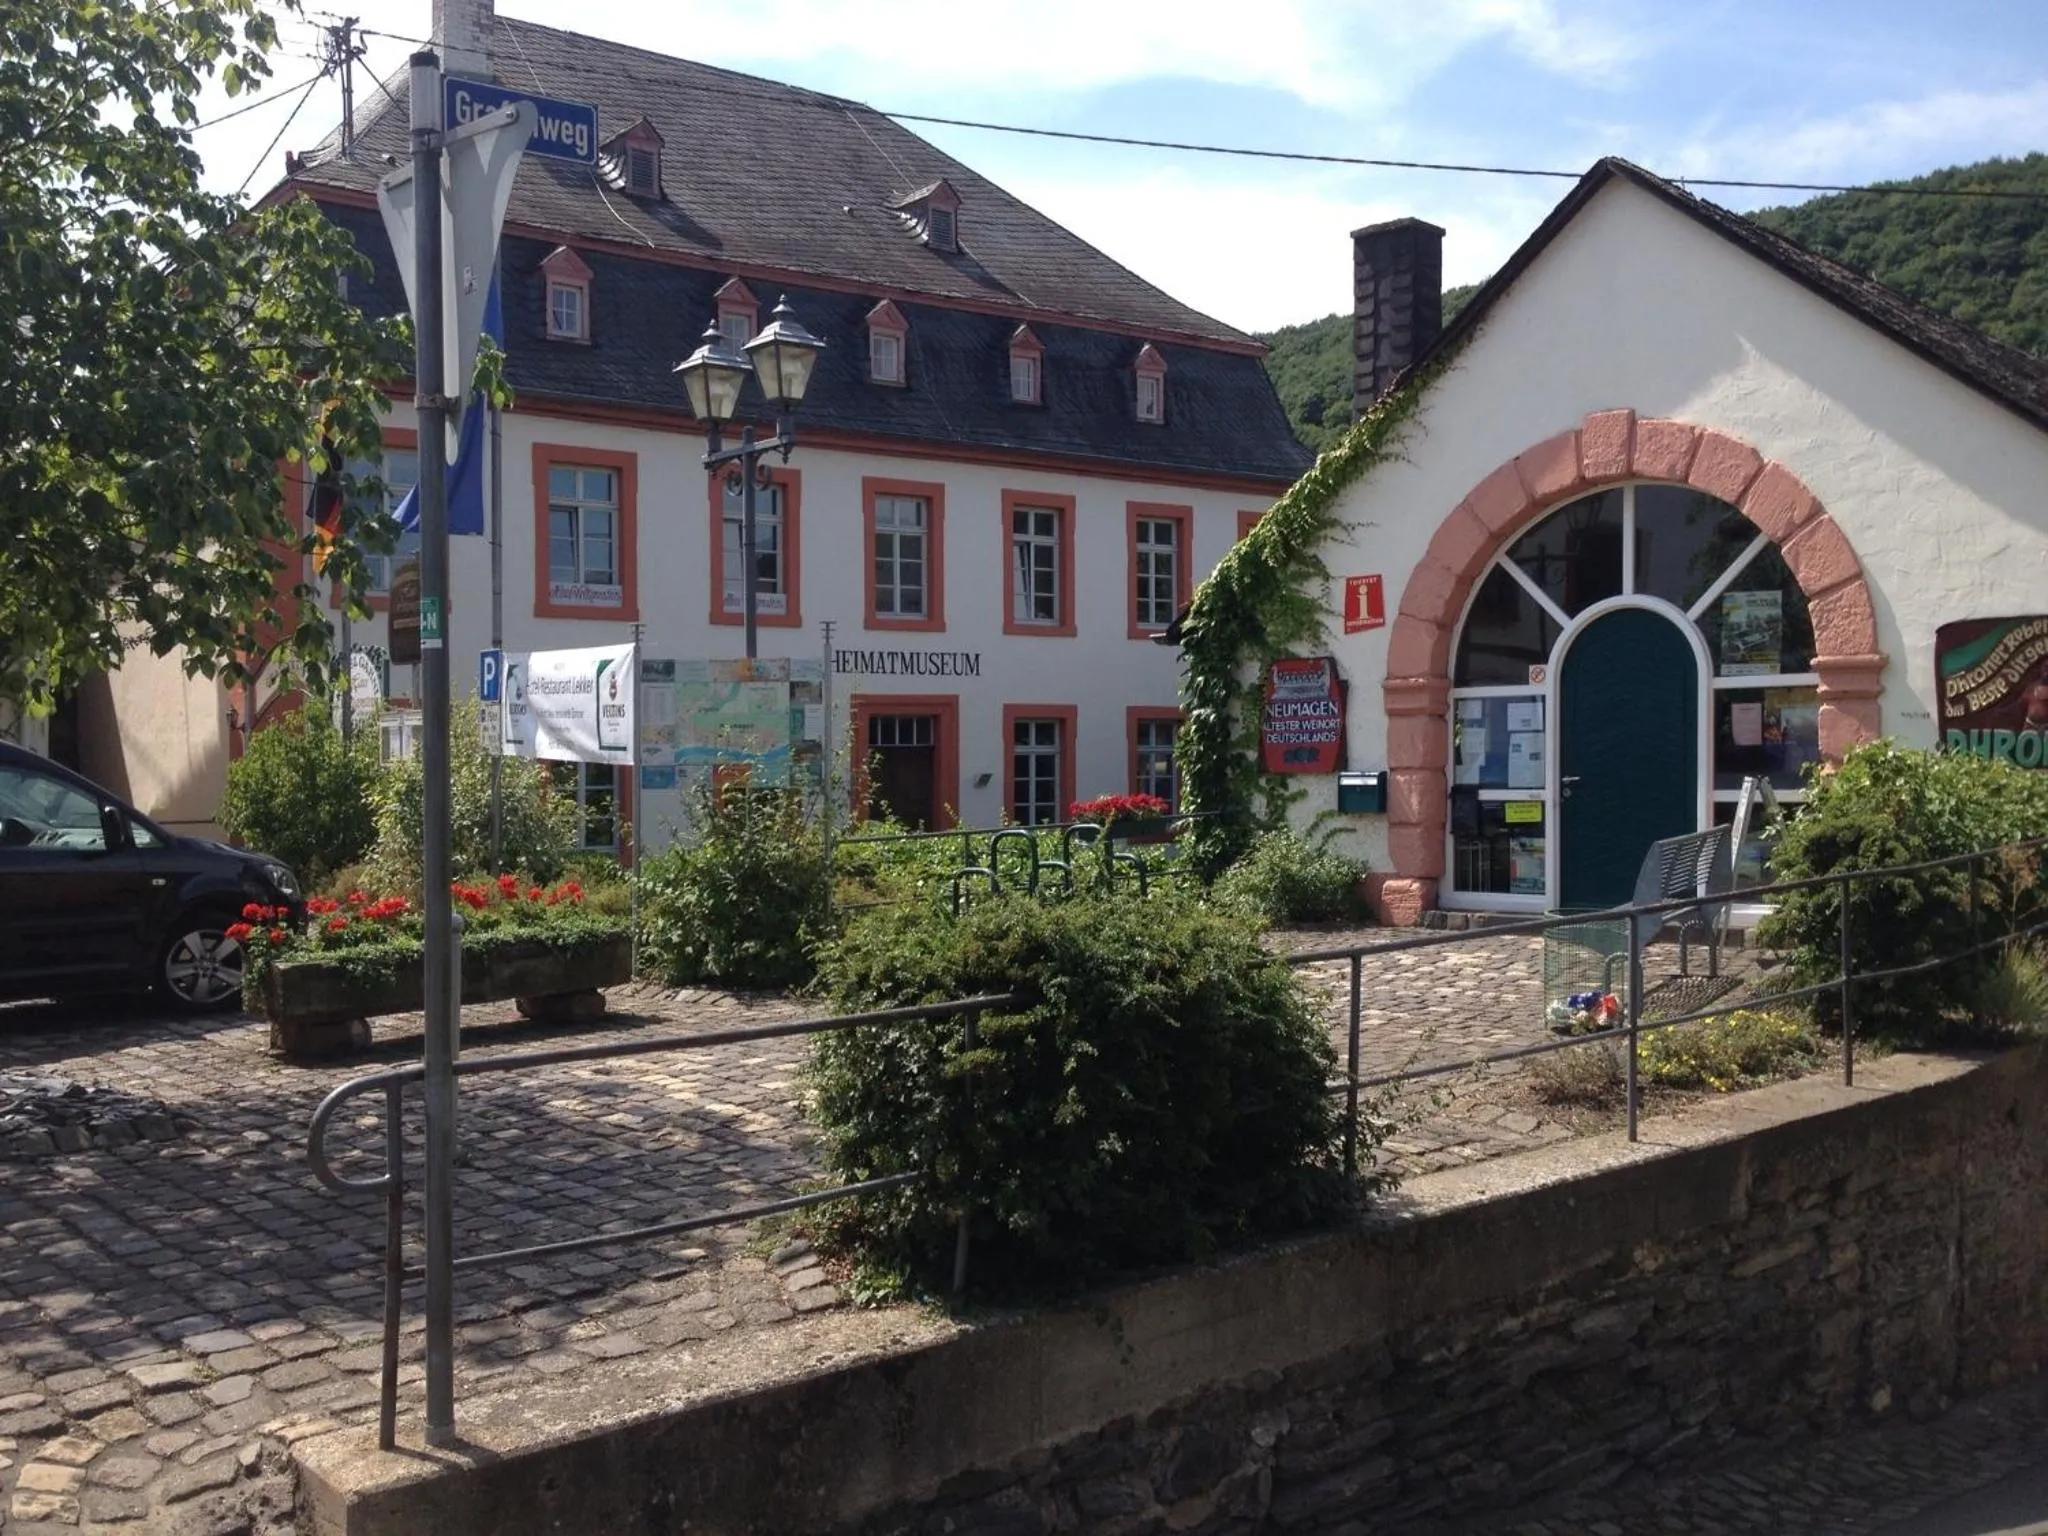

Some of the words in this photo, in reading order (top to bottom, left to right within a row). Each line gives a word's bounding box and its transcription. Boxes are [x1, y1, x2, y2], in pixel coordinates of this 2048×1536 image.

[829, 650, 981, 676] HEIMATMUSEUM
[484, 656, 496, 696] P
[1265, 701, 1339, 718] NEUMAGEN
[1301, 718, 1341, 731] WEINORT
[1266, 731, 1337, 744] DEUTSCHLANDS
